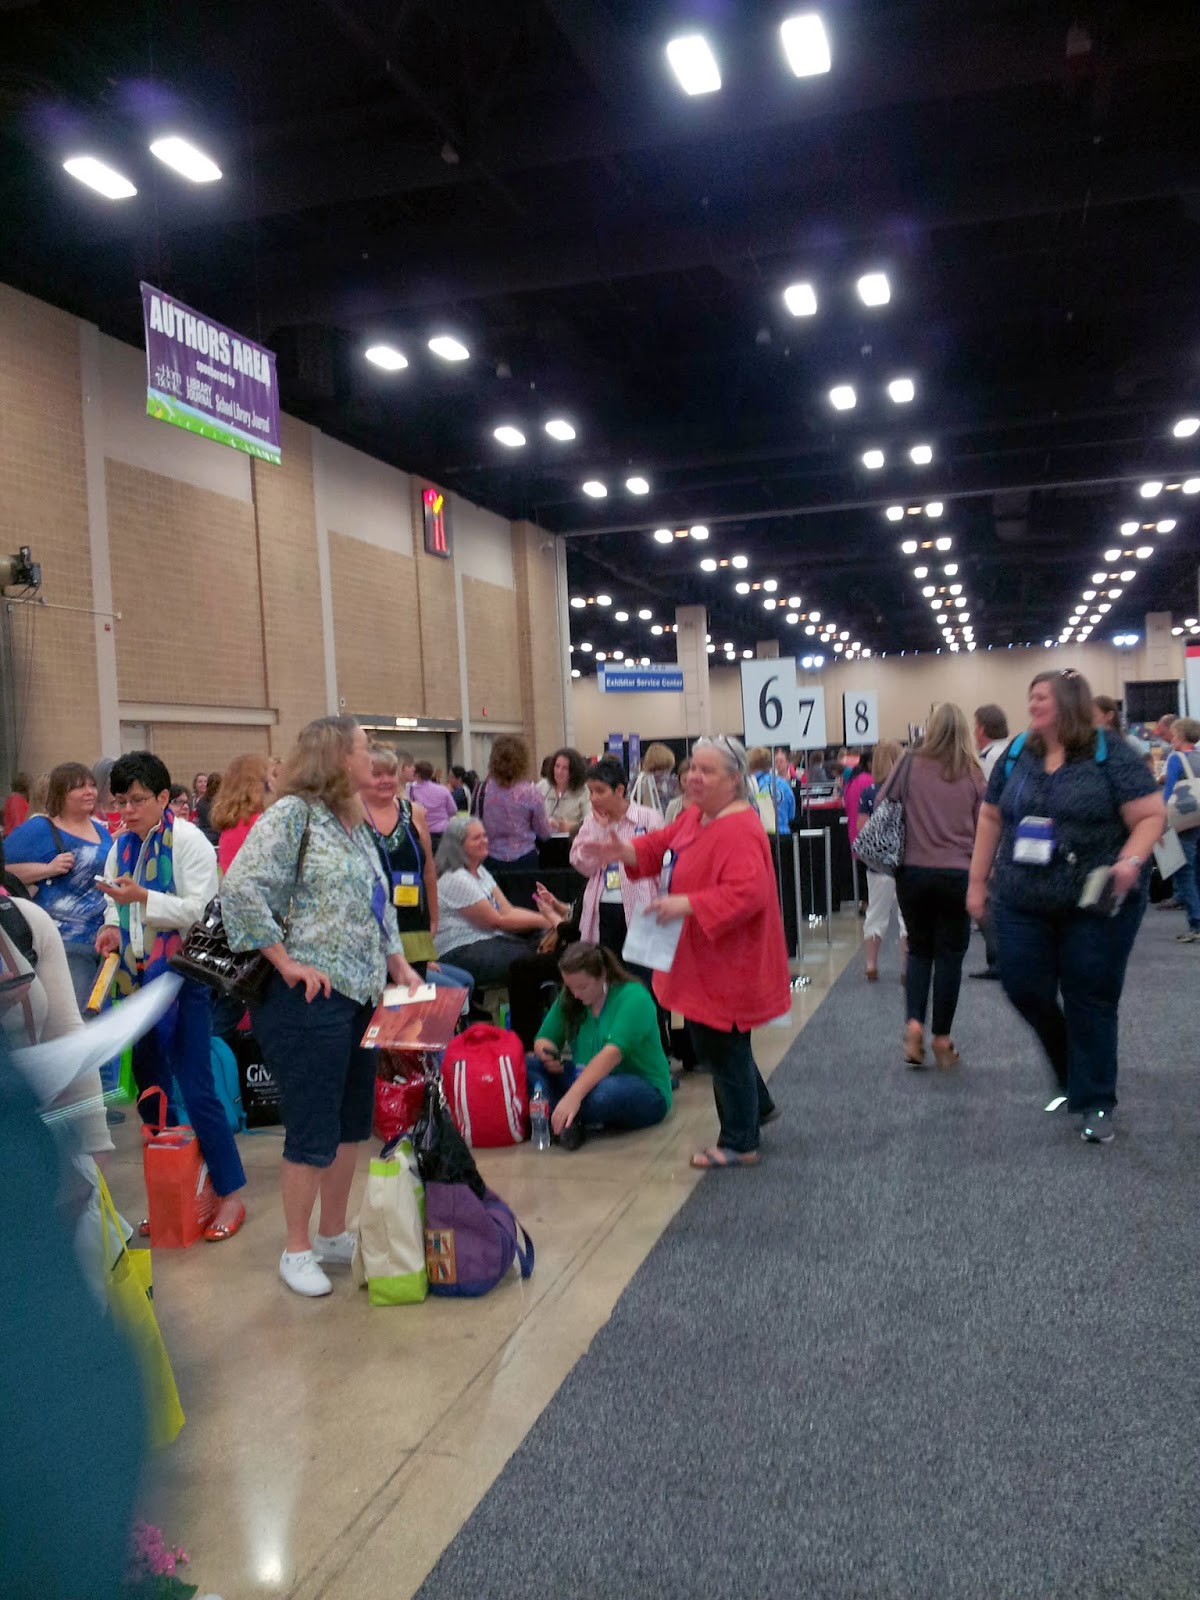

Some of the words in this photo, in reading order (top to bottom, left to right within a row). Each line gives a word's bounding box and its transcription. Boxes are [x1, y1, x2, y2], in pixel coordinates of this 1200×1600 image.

[149, 295, 230, 366] AUTHORS
[231, 339, 271, 386] AREA
[606, 676, 635, 688] Exhibitor
[636, 676, 660, 688] Service
[661, 676, 683, 688] Center
[758, 675, 784, 730] 6
[798, 698, 815, 737] 7
[854, 699, 870, 735] 8
